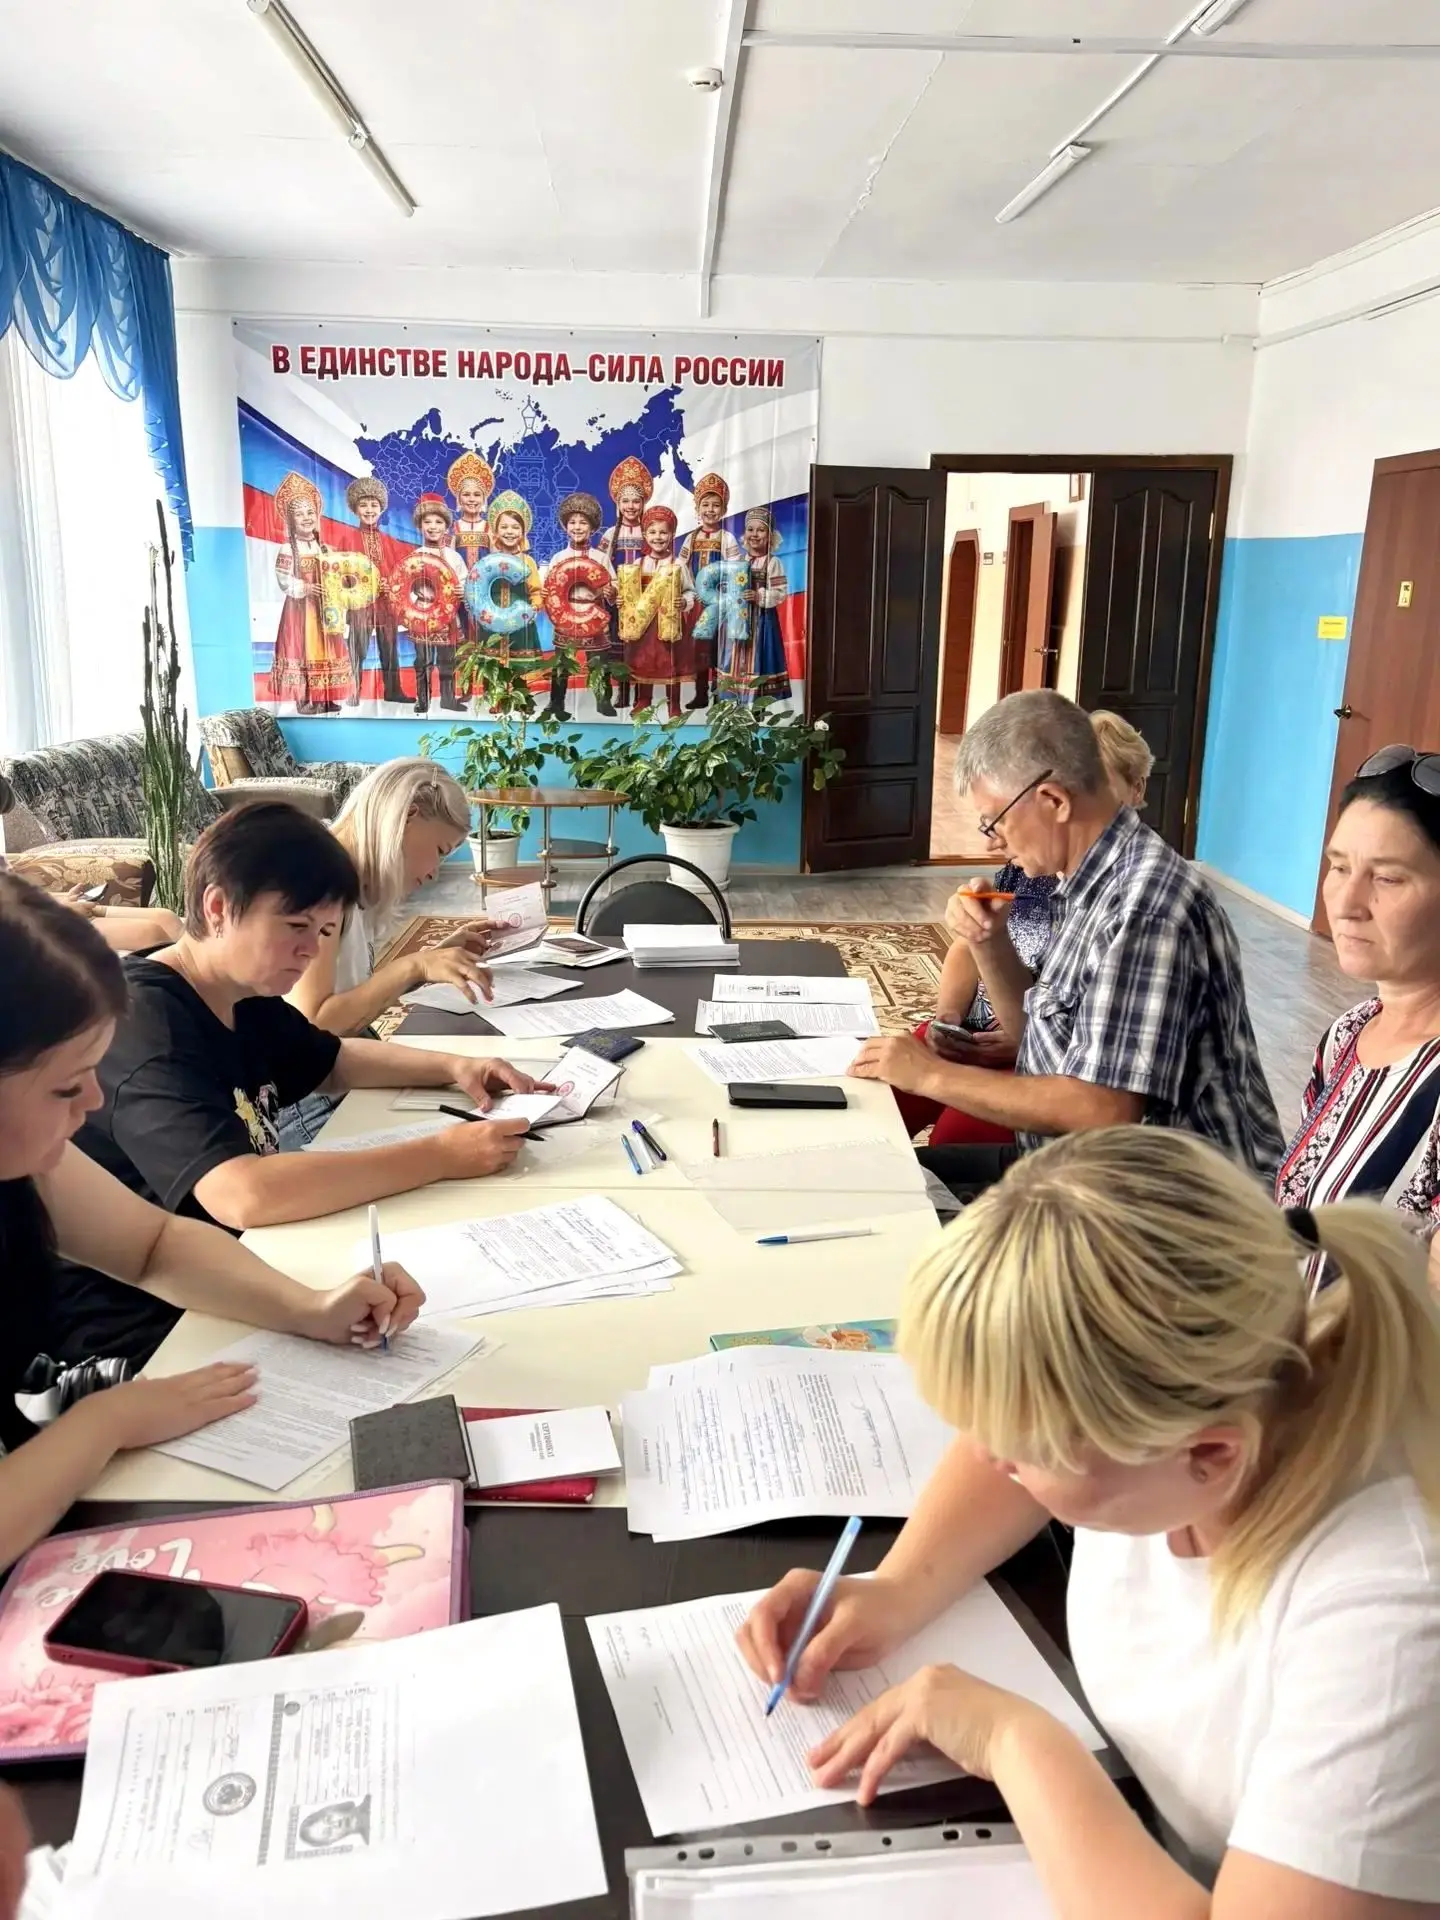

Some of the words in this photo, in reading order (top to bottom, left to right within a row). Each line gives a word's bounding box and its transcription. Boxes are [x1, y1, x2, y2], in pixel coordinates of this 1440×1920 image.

[271, 344, 290, 374] В
[299, 345, 448, 380] ЕДИНСТВЕ
[674, 355, 786, 388] РОССИИ
[317, 550, 752, 643] РОССИЯ
[71, 1536, 202, 1581] Love
